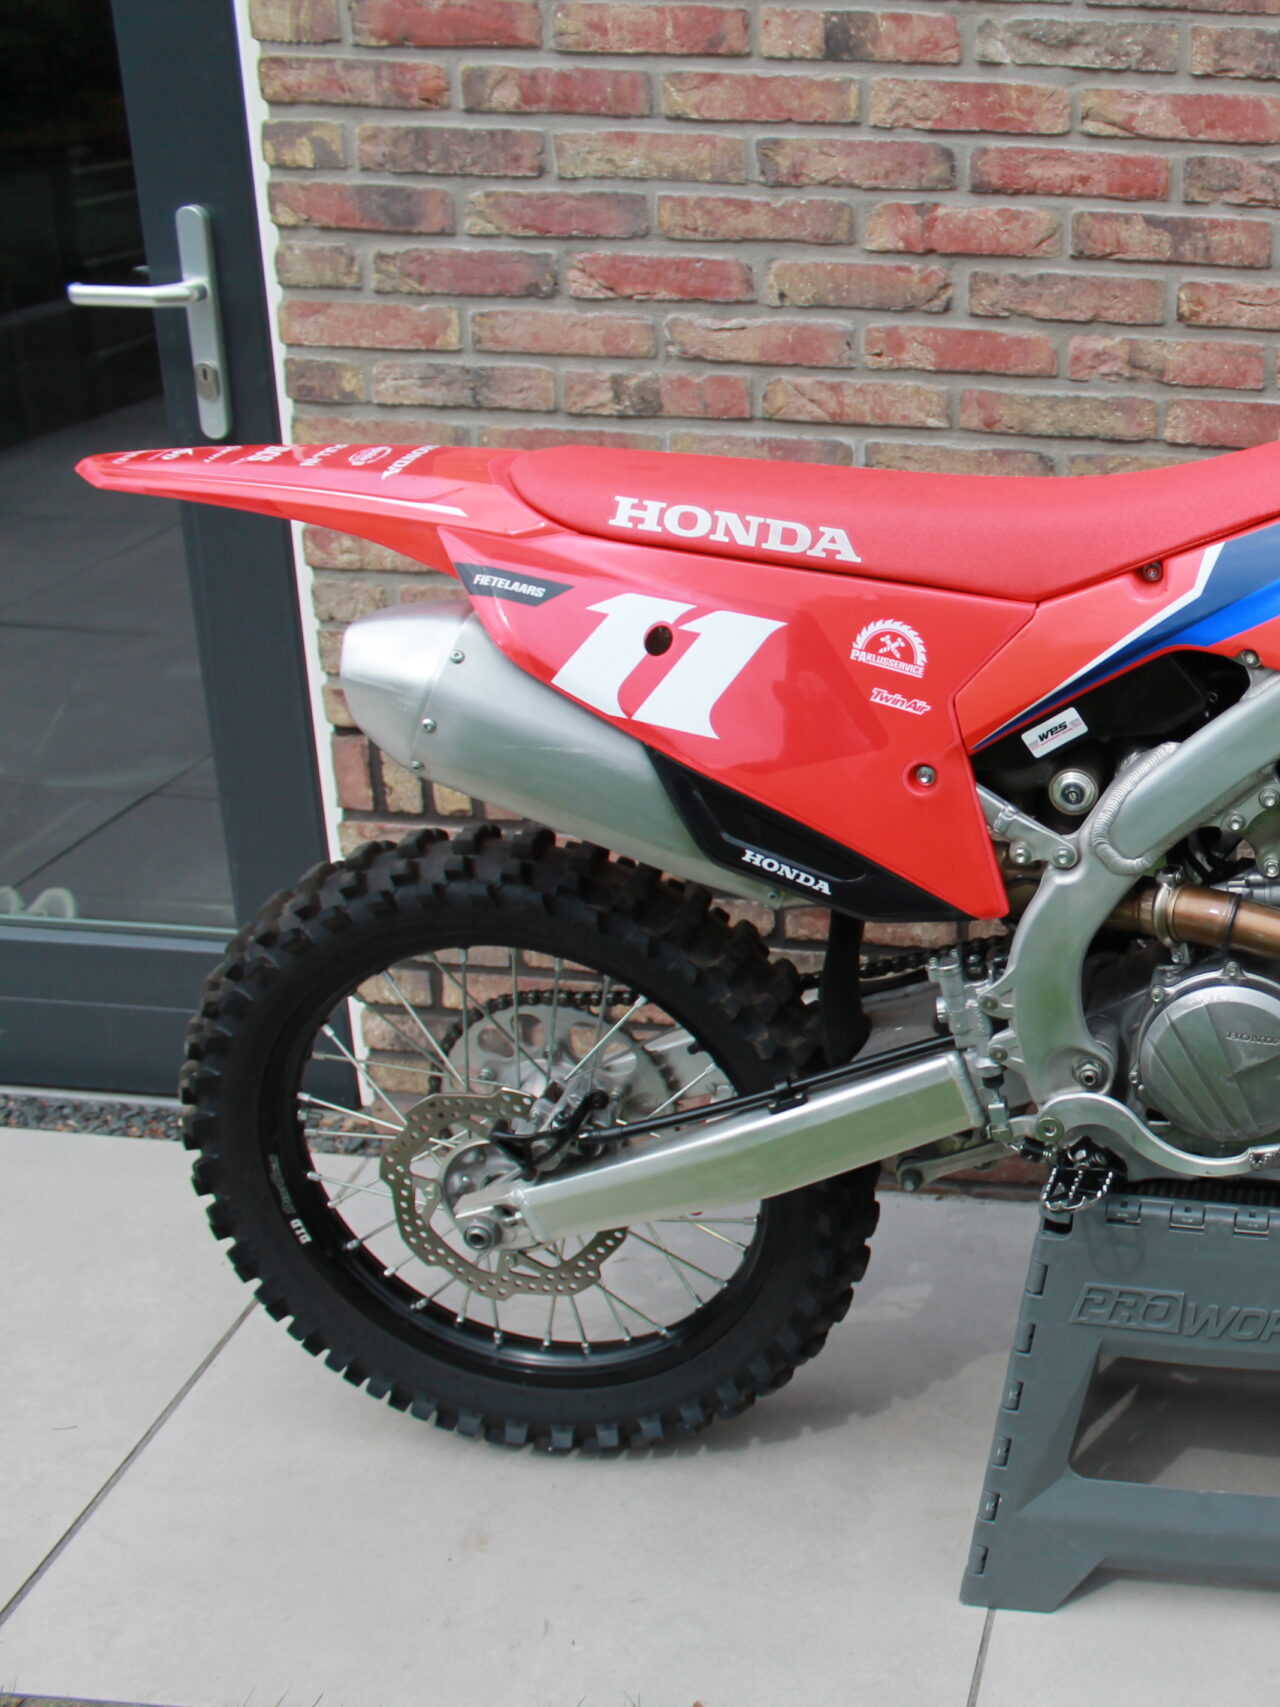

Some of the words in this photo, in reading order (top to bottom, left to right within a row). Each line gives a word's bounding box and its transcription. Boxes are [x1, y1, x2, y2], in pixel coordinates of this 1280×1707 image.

[608, 495, 862, 563] HONDA
[473, 573, 547, 598] FIETELAARS
[552, 592, 788, 740] 11
[1038, 721, 1068, 742] WPS
[741, 849, 832, 895] HONDA
